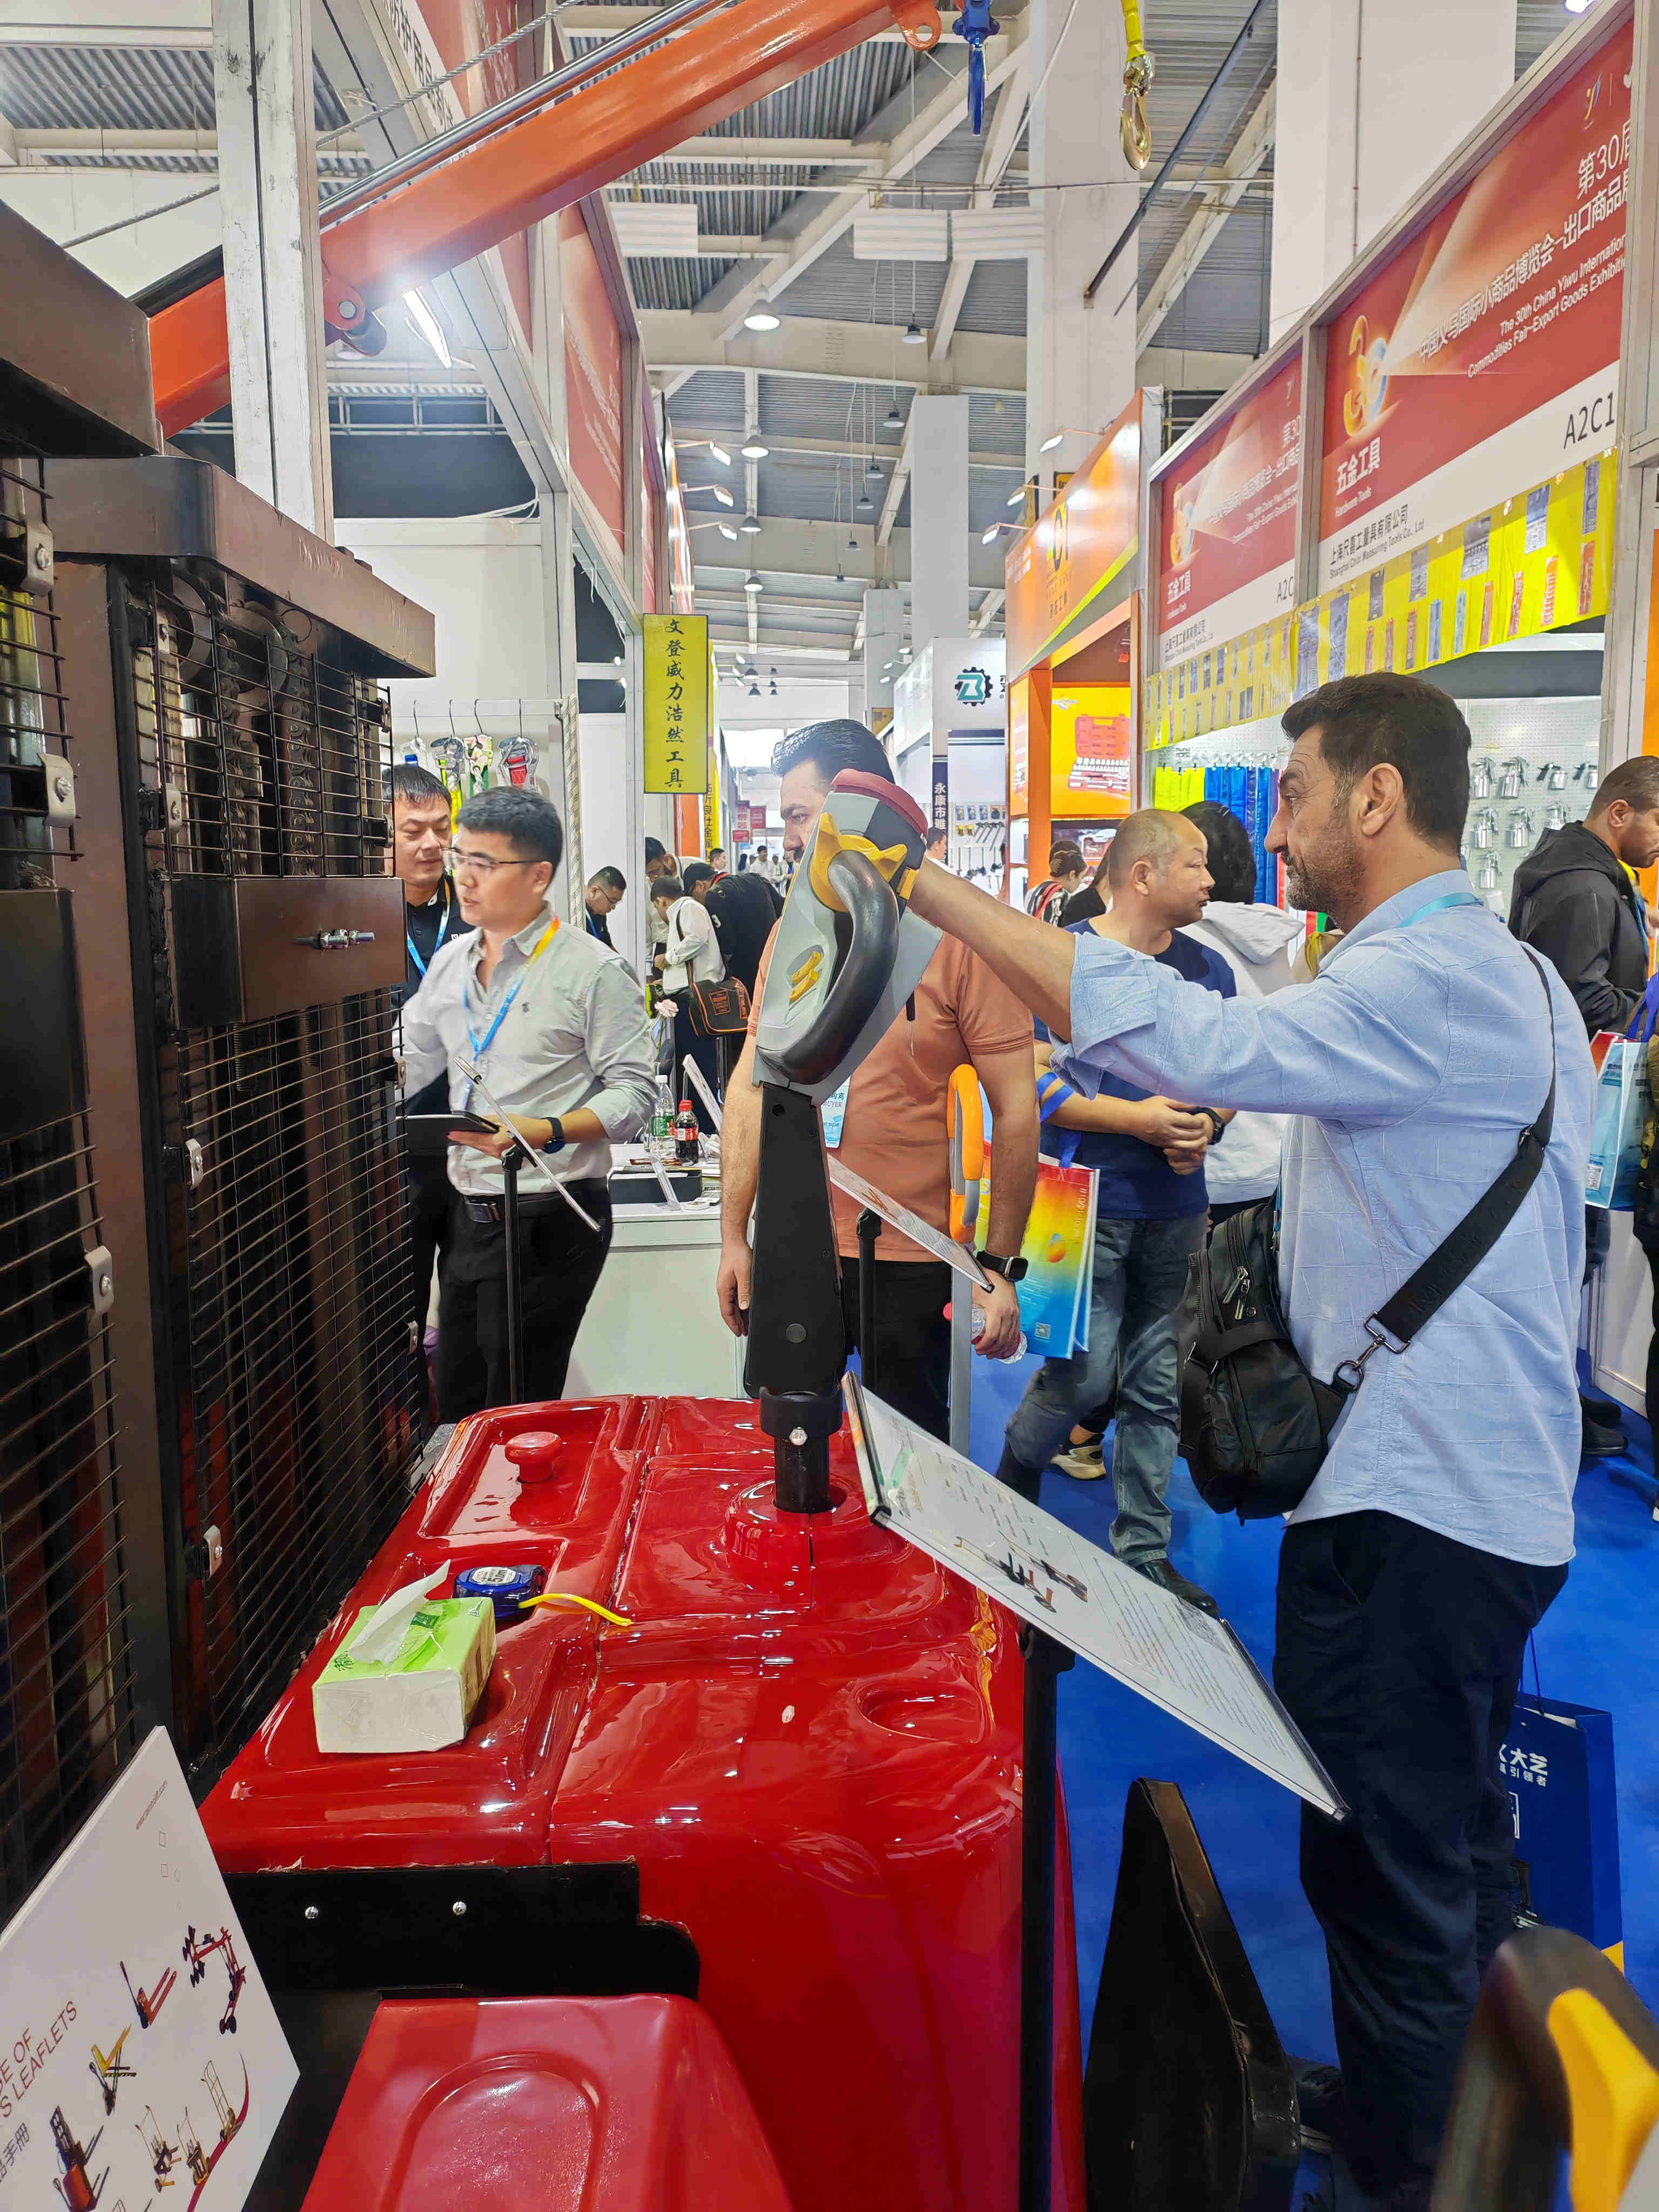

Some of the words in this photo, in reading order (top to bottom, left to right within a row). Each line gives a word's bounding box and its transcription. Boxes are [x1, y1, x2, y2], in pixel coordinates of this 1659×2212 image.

[1500, 319, 1514, 337] The
[1533, 287, 1556, 312] China
[1557, 271, 1578, 294] Yiwu
[1563, 391, 1615, 449] A2C1
[1336, 436, 1381, 496] 五金工具
[665, 618, 686, 788] 文登威力浩然工具
[12, 2001, 77, 2100] LEAFLETS
[14, 2028, 31, 2063] OF
